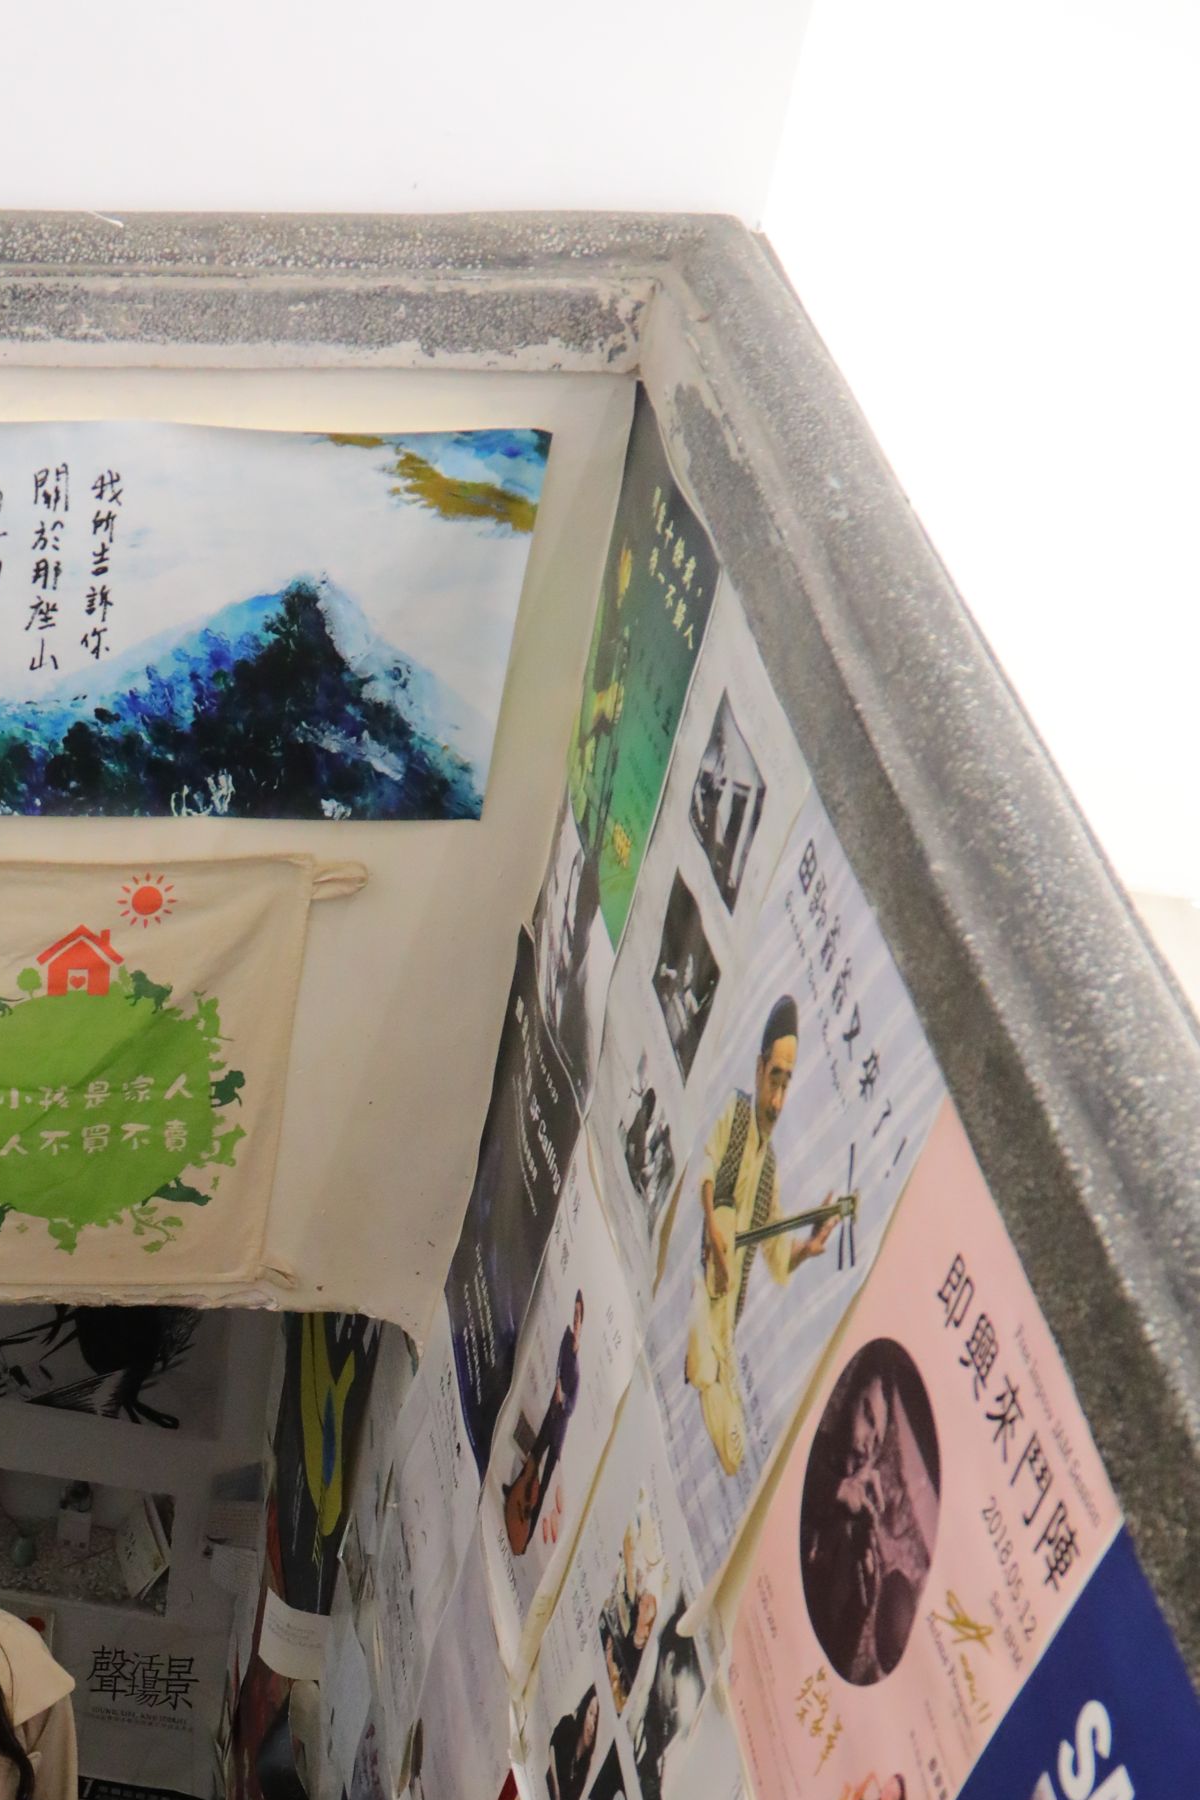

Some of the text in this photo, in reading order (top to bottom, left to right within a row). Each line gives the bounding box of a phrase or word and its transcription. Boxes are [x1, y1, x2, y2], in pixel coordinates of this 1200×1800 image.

[23, 462, 71, 672] 關於那座山
[79, 467, 124, 662] 我所告訴你
[537, 1115, 561, 1198] Calling
[935, 1247, 1083, 1602] 即興來鬥陣
[1067, 1454, 1104, 1532] Session
[980, 1492, 1039, 1645] 2018.05.12
